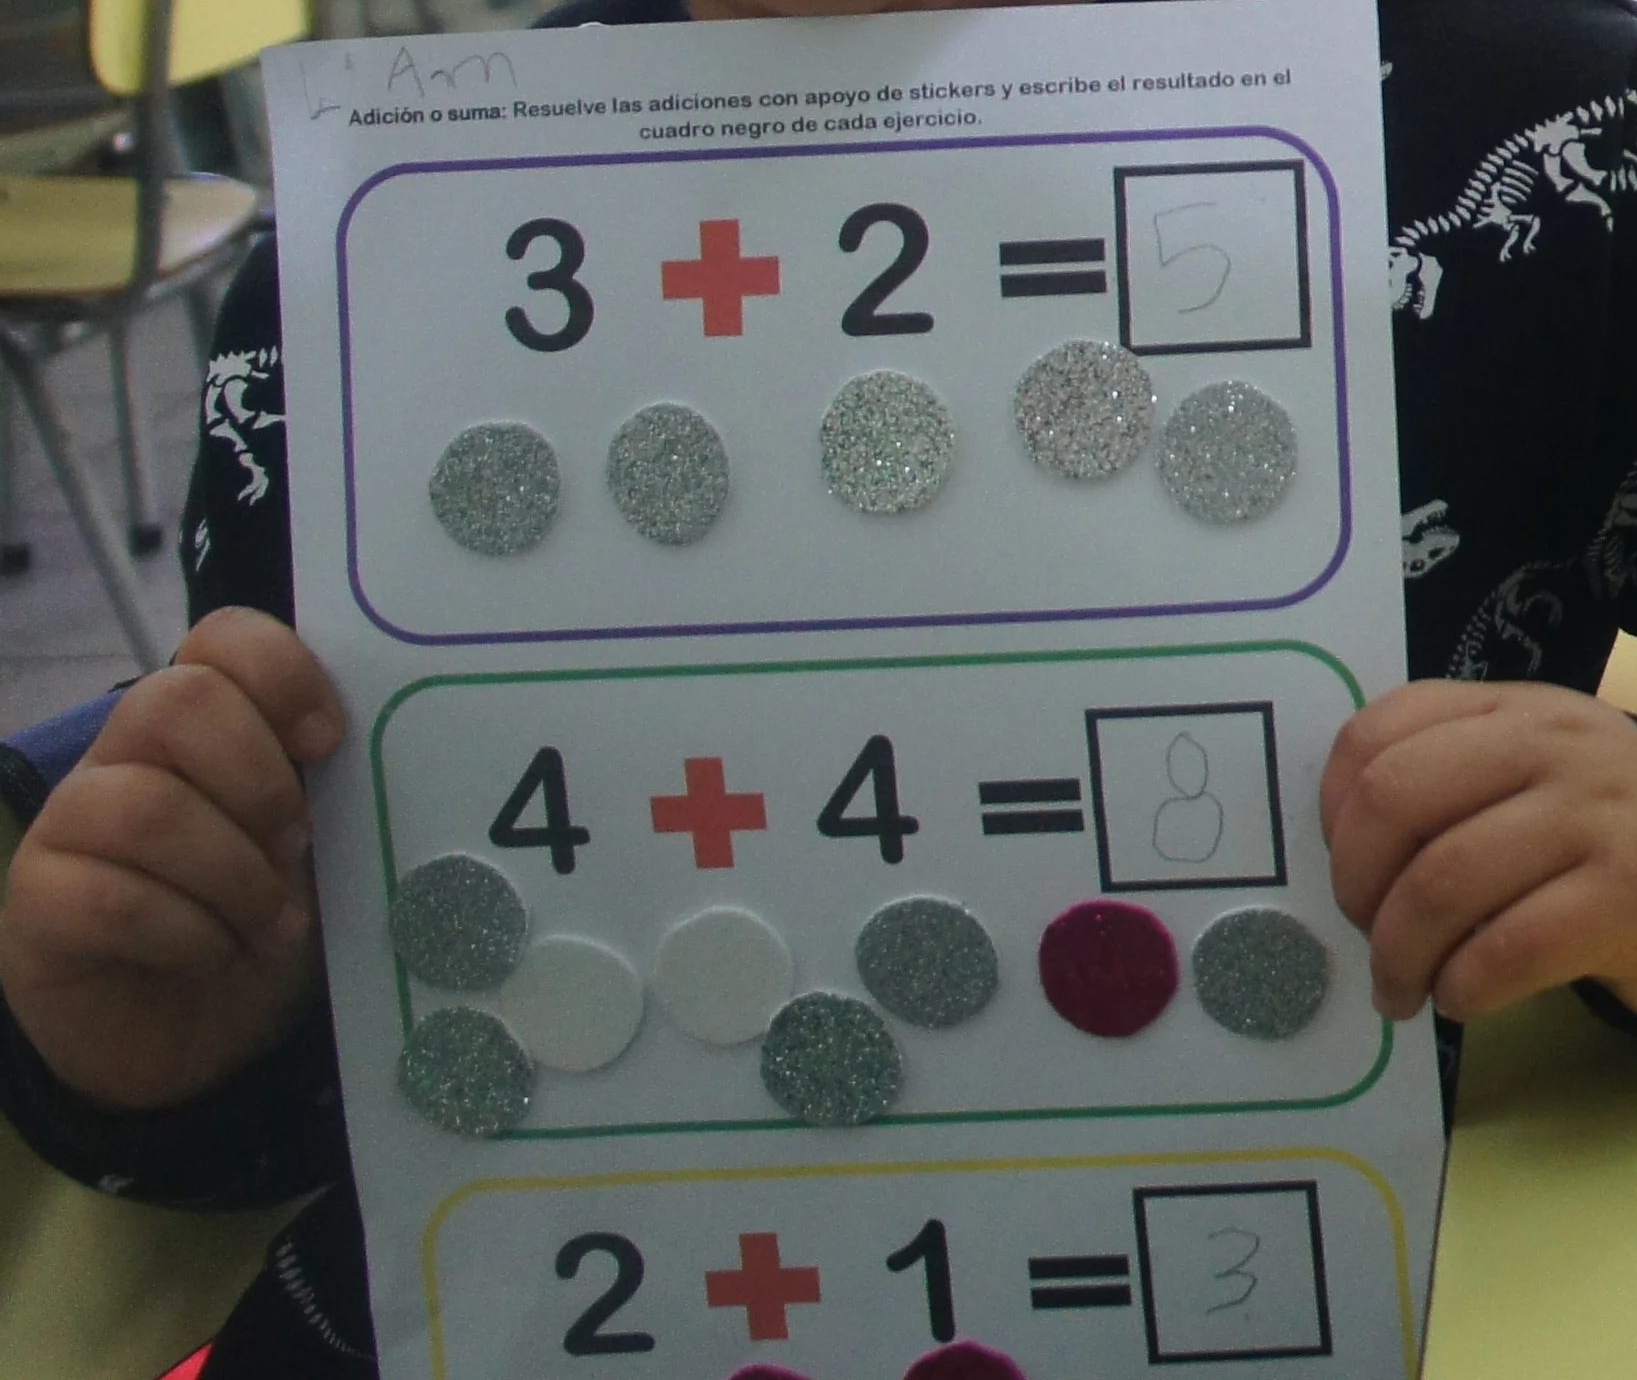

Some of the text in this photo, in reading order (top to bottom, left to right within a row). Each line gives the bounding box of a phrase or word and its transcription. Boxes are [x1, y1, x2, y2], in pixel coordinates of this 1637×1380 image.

[348, 68, 1291, 128] Adición o suma: Resuelve las adiciones con apoyo de stickers y escribe el resultado en el
[639, 109, 982, 141] cuadro negro de cada ejercicio.
[503, 217, 595, 352] 3
[837, 202, 934, 336] 2
[998, 236, 1108, 299] =
[1152, 200, 1232, 313] 5
[488, 745, 590, 875] 4
[816, 734, 919, 865] 4
[978, 777, 1084, 834] =
[1152, 731, 1224, 863] 8
[555, 1231, 656, 1356] 2
[886, 1219, 956, 1342] 1
[1028, 1254, 1132, 1308] =
[1204, 1226, 1261, 1315] 3
